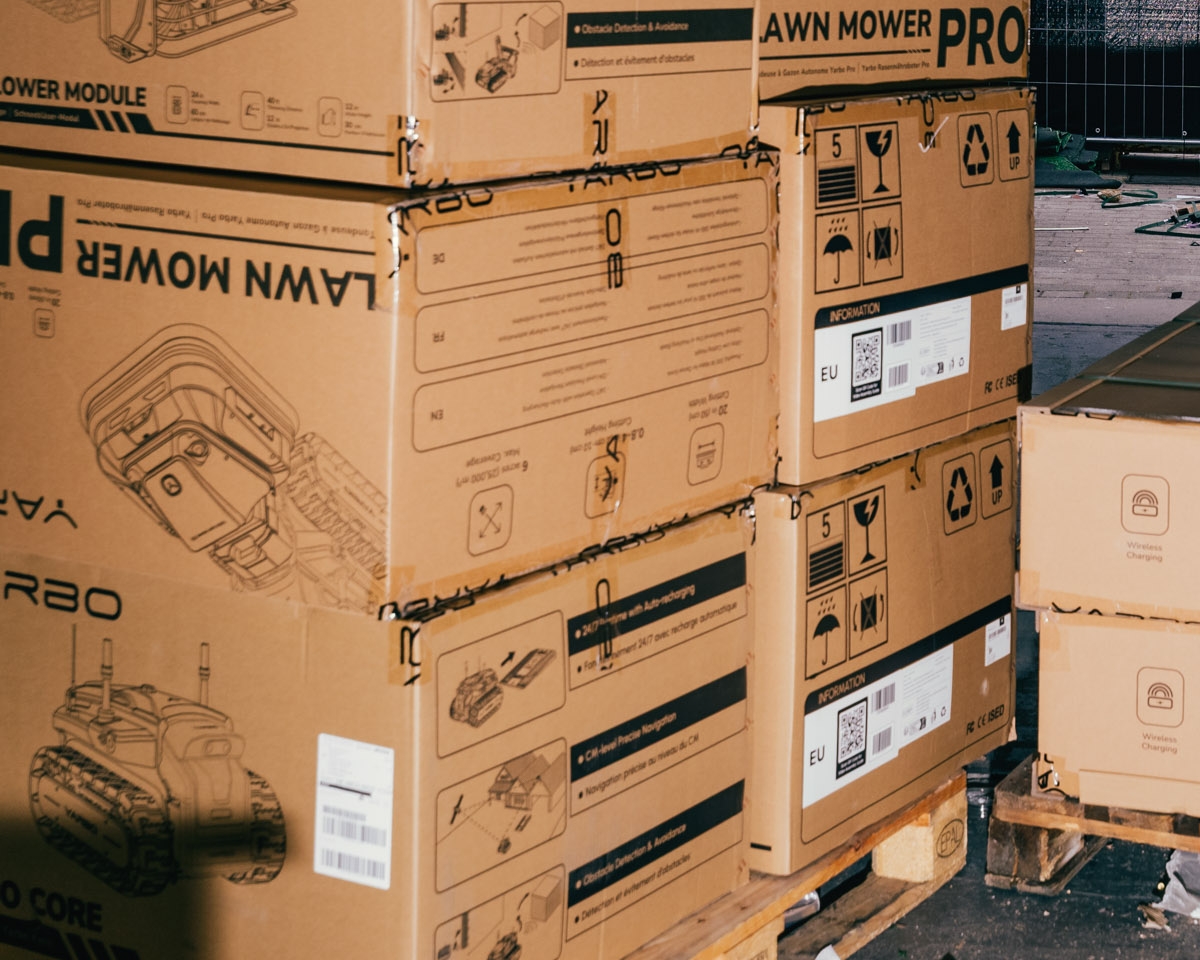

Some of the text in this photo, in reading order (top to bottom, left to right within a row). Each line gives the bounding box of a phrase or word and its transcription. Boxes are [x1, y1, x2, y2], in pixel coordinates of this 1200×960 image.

[582, 21, 689, 35] Obstacle Detection Avoidance
[759, 9, 932, 43] AWN MOWER
[936, 5, 1027, 68] PRO
[581, 53, 695, 68] Détection et évitement d'obstacles
[65, 81, 147, 107] MODULE
[832, 133, 842, 158] 5
[1009, 156, 1021, 171] UP
[77, 199, 192, 219] Yarbo Pro
[202, 212, 320, 234] Gazon Autonome Yarbo Pro
[432, 252, 445, 264] DE
[76, 239, 376, 311] LAWN MOWER
[829, 301, 881, 324] INFORMATION
[432, 331, 445, 343] FR
[821, 363, 838, 382] EU
[688, 390, 730, 408] Cutting Width
[430, 408, 444, 421] EN
[584, 415, 632, 437] Cutting Height
[466, 446, 521, 468] Max. Coverage
[501, 462, 520, 476] acres
[992, 490, 1003, 506] UP
[822, 512, 832, 538] 5
[1126, 551, 1163, 563] Charging
[1127, 541, 1163, 552] Wireless
[4, 571, 122, 621] RBO
[582, 584, 696, 637] 24/7 with Auto-recharging
[639, 601, 738, 649] 24/7 avec recharge automatique
[818, 672, 866, 705] INFORMATION
[988, 703, 1005, 724] ISED
[617, 712, 677, 746] Precise Navigation
[1142, 732, 1178, 744] Wireless
[809, 744, 826, 767] EU
[1141, 742, 1178, 754] Charging
[585, 739, 688, 796] Navigation précise au niveau du
[583, 823, 687, 887] Obstacle Detection Avoidance
[581, 852, 691, 921] Détection et évitement d'obstacles
[30, 886, 104, 932] CORE
